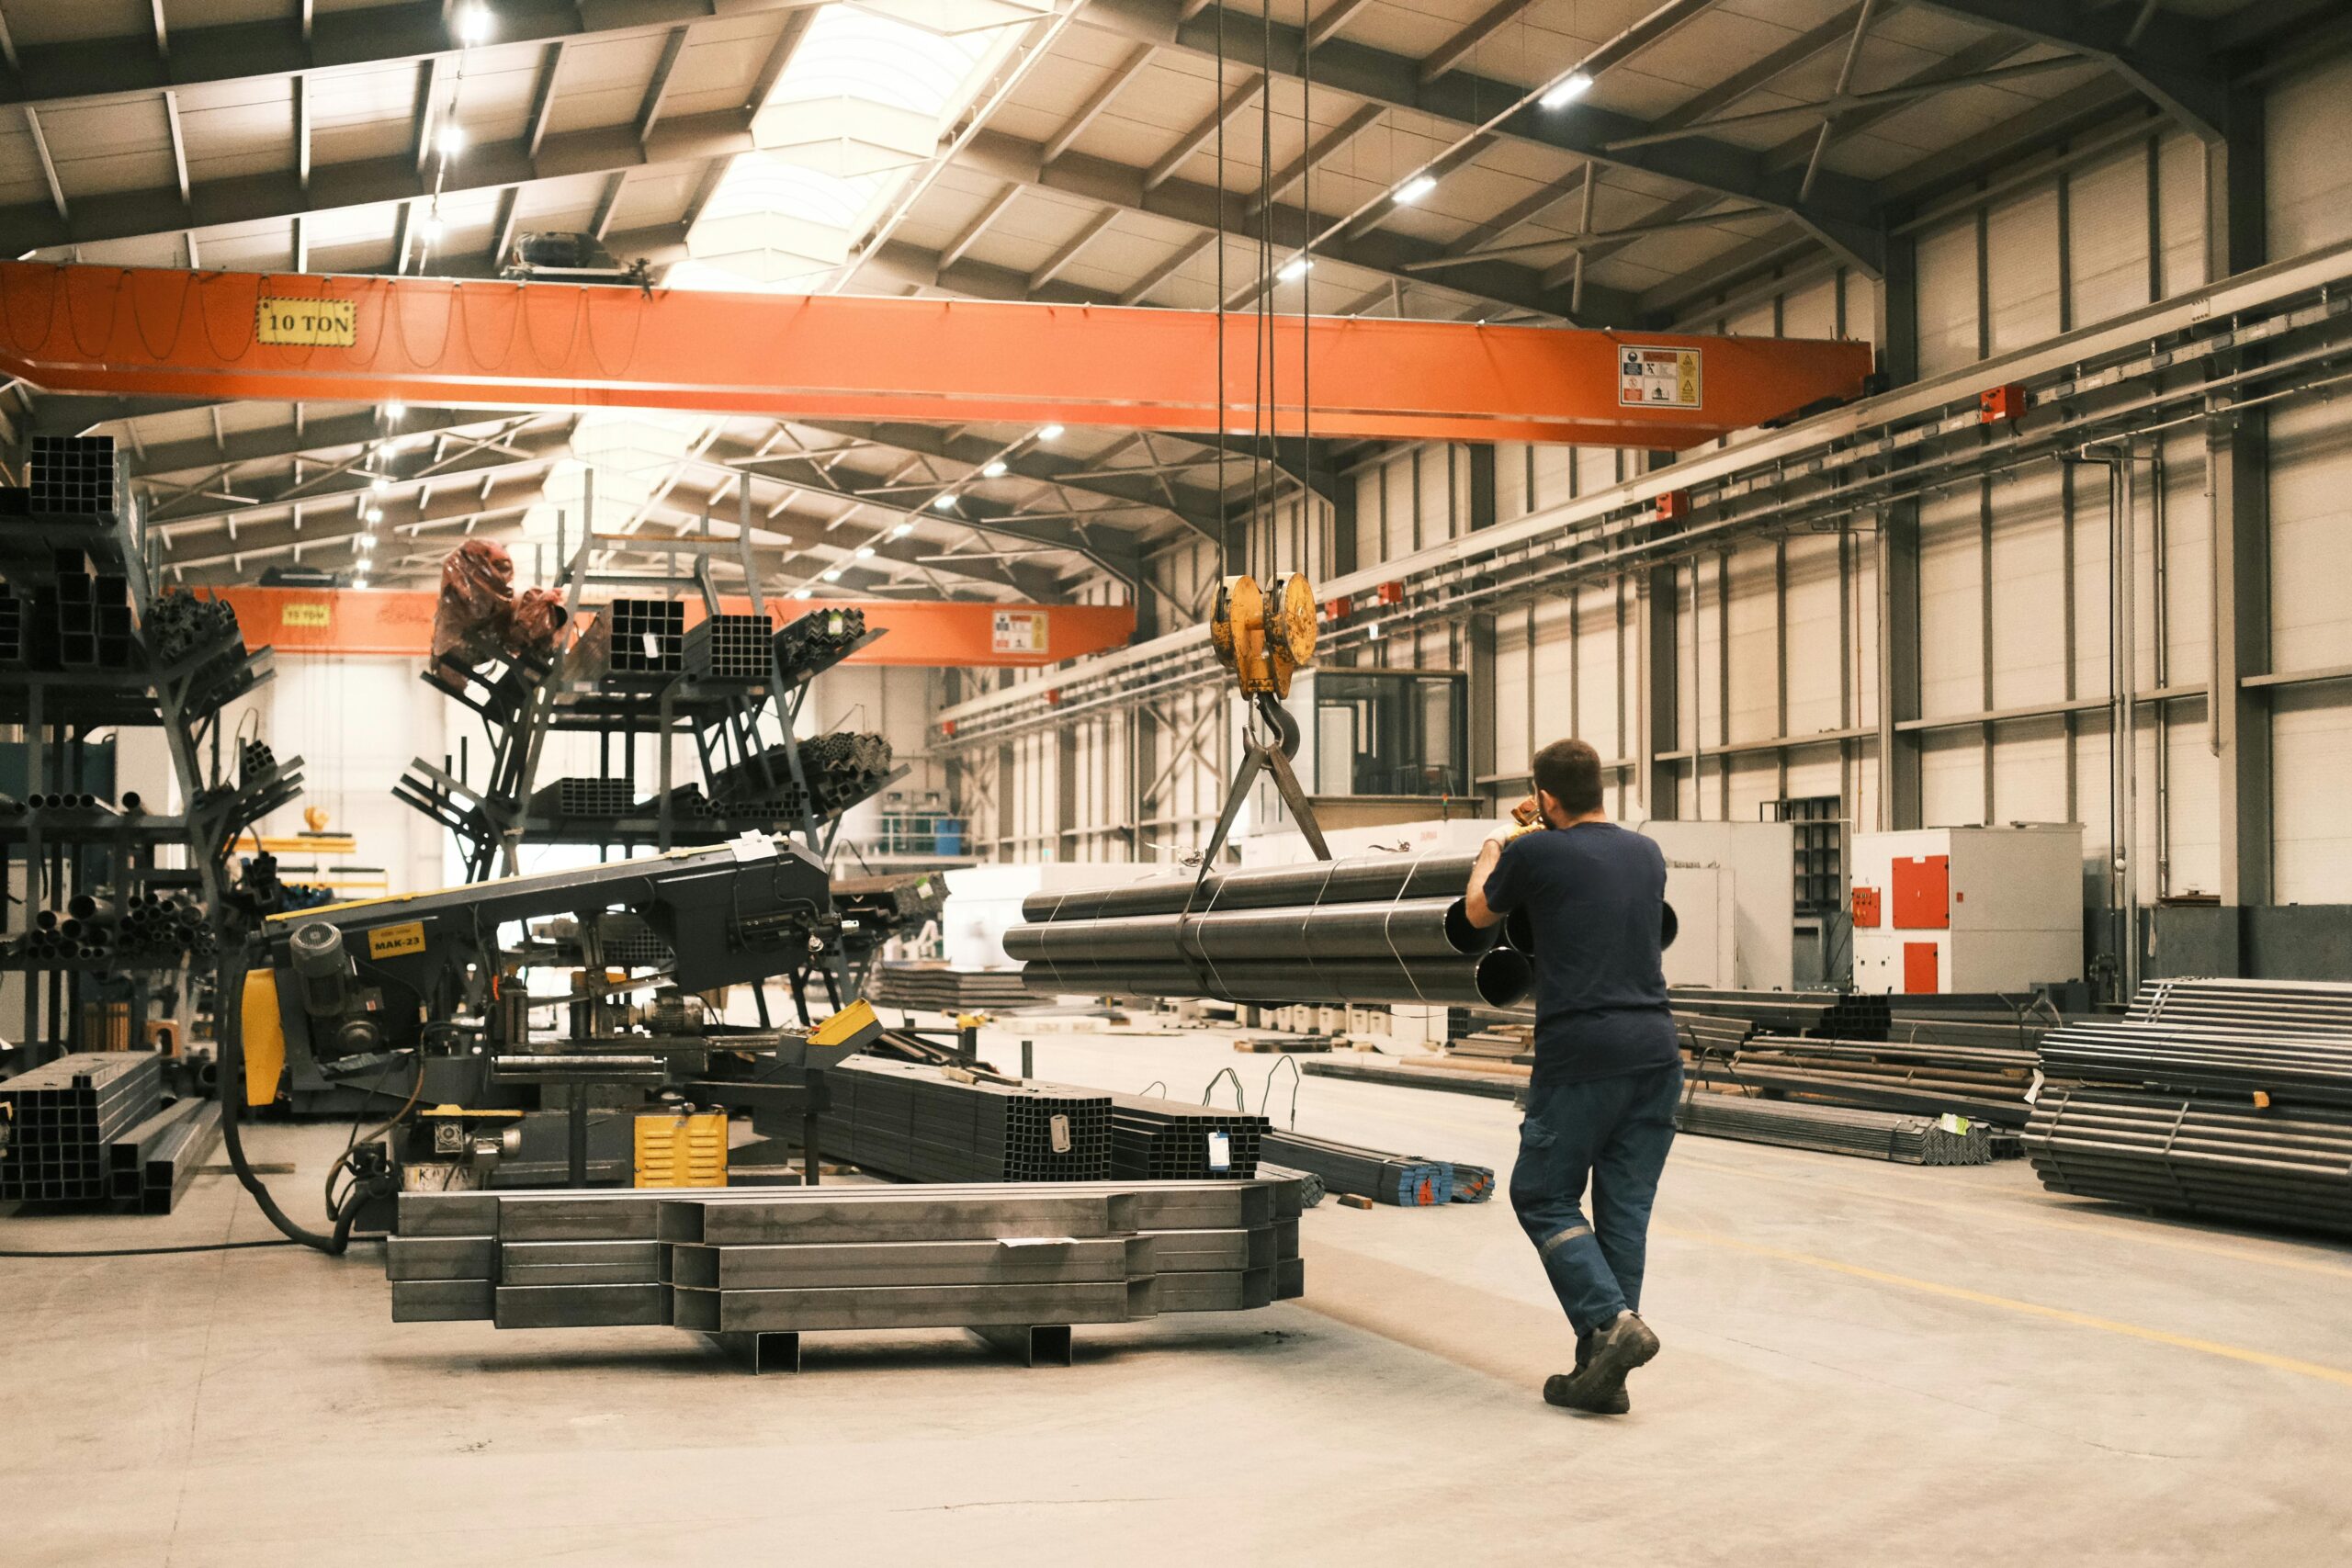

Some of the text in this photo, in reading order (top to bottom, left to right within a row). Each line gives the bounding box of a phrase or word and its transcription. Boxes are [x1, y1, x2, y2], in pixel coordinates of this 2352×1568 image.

[269, 315, 349, 333] 10 TON
[375, 937, 420, 951] MAK-23
